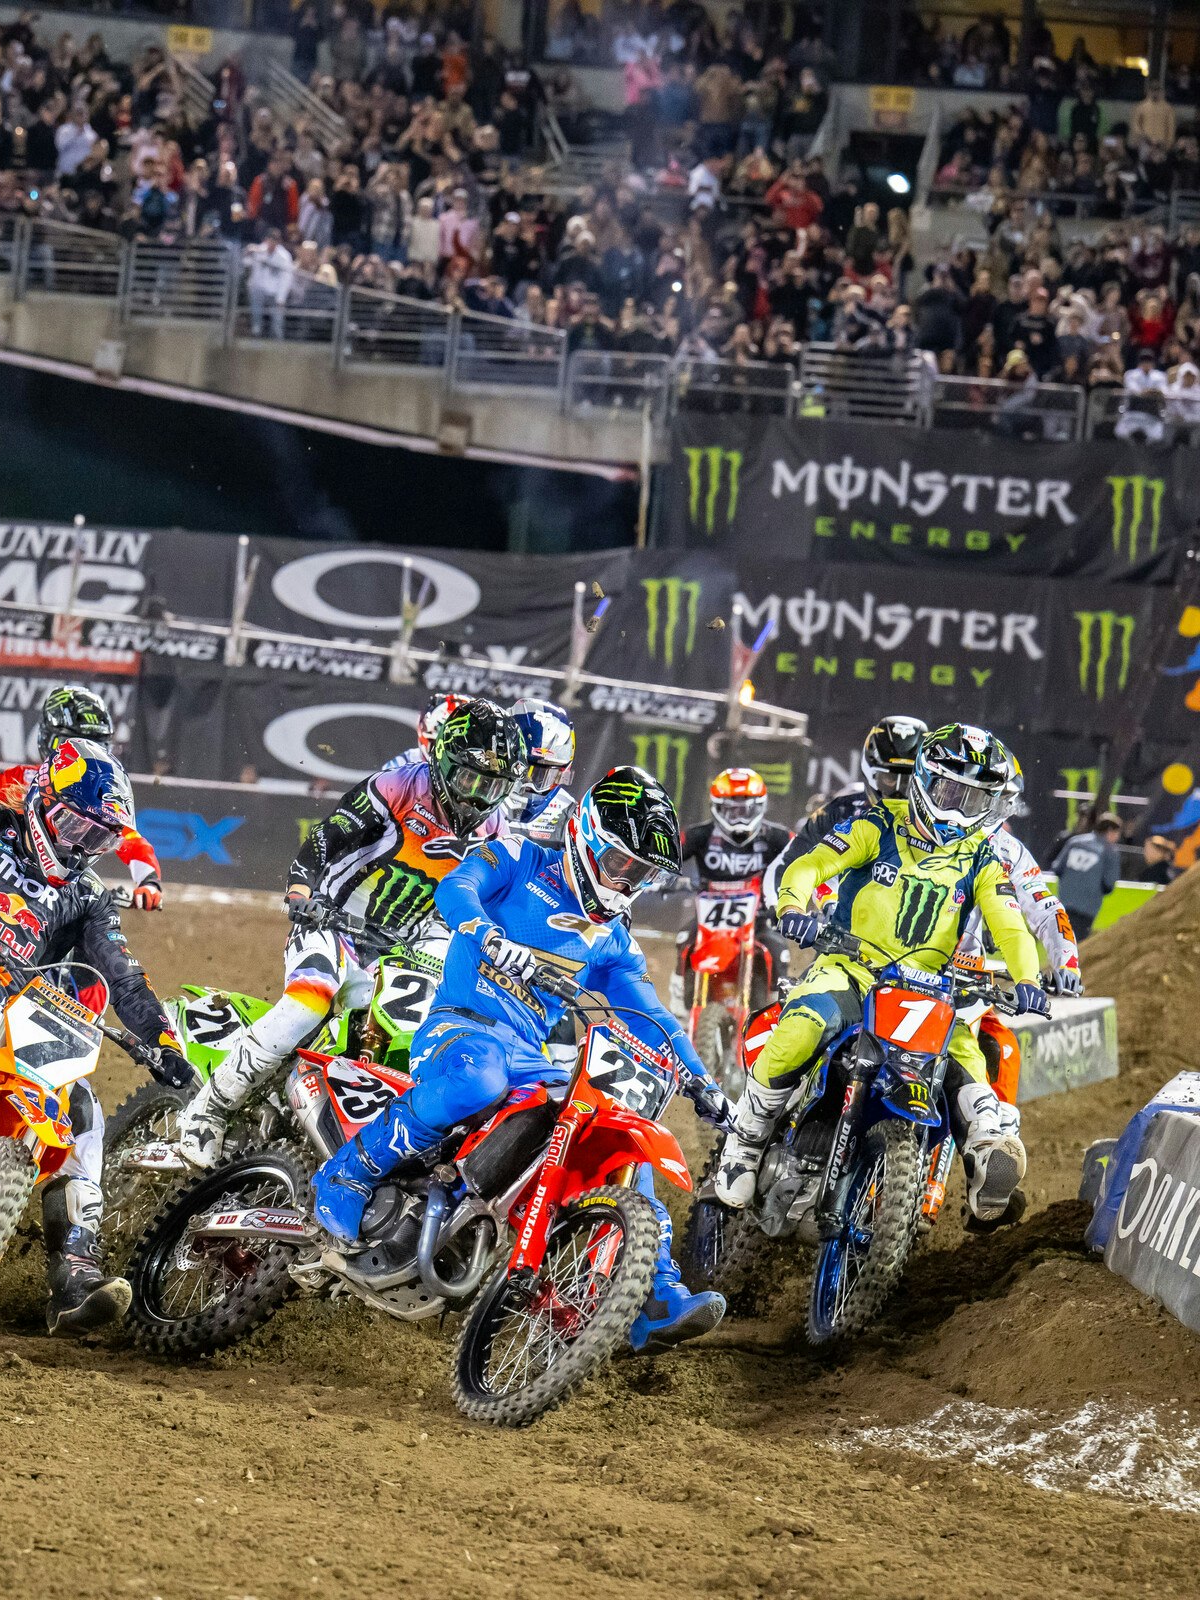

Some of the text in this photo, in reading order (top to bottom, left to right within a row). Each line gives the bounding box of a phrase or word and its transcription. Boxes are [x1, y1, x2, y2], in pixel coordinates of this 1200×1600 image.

[771, 457, 1077, 524] MONSTER
[814, 516, 1027, 554] ENERGY
[733, 589, 1044, 660] MONSTER
[776, 651, 992, 688] ENERGY
[136, 808, 246, 865] SX
[406, 818, 428, 835] Airoh
[523, 881, 561, 910] SHOWA
[705, 901, 748, 930] 45
[38, 986, 88, 1021] RENTHAL
[889, 998, 938, 1044] 1
[13, 1009, 94, 1070] 7
[371, 1064, 414, 1085] HONDA
[587, 1050, 664, 1121] 23
[827, 1120, 852, 1193] DUNLOP
[519, 1184, 548, 1251] DUNLOP
[582, 1197, 618, 1209] DUNLOP
